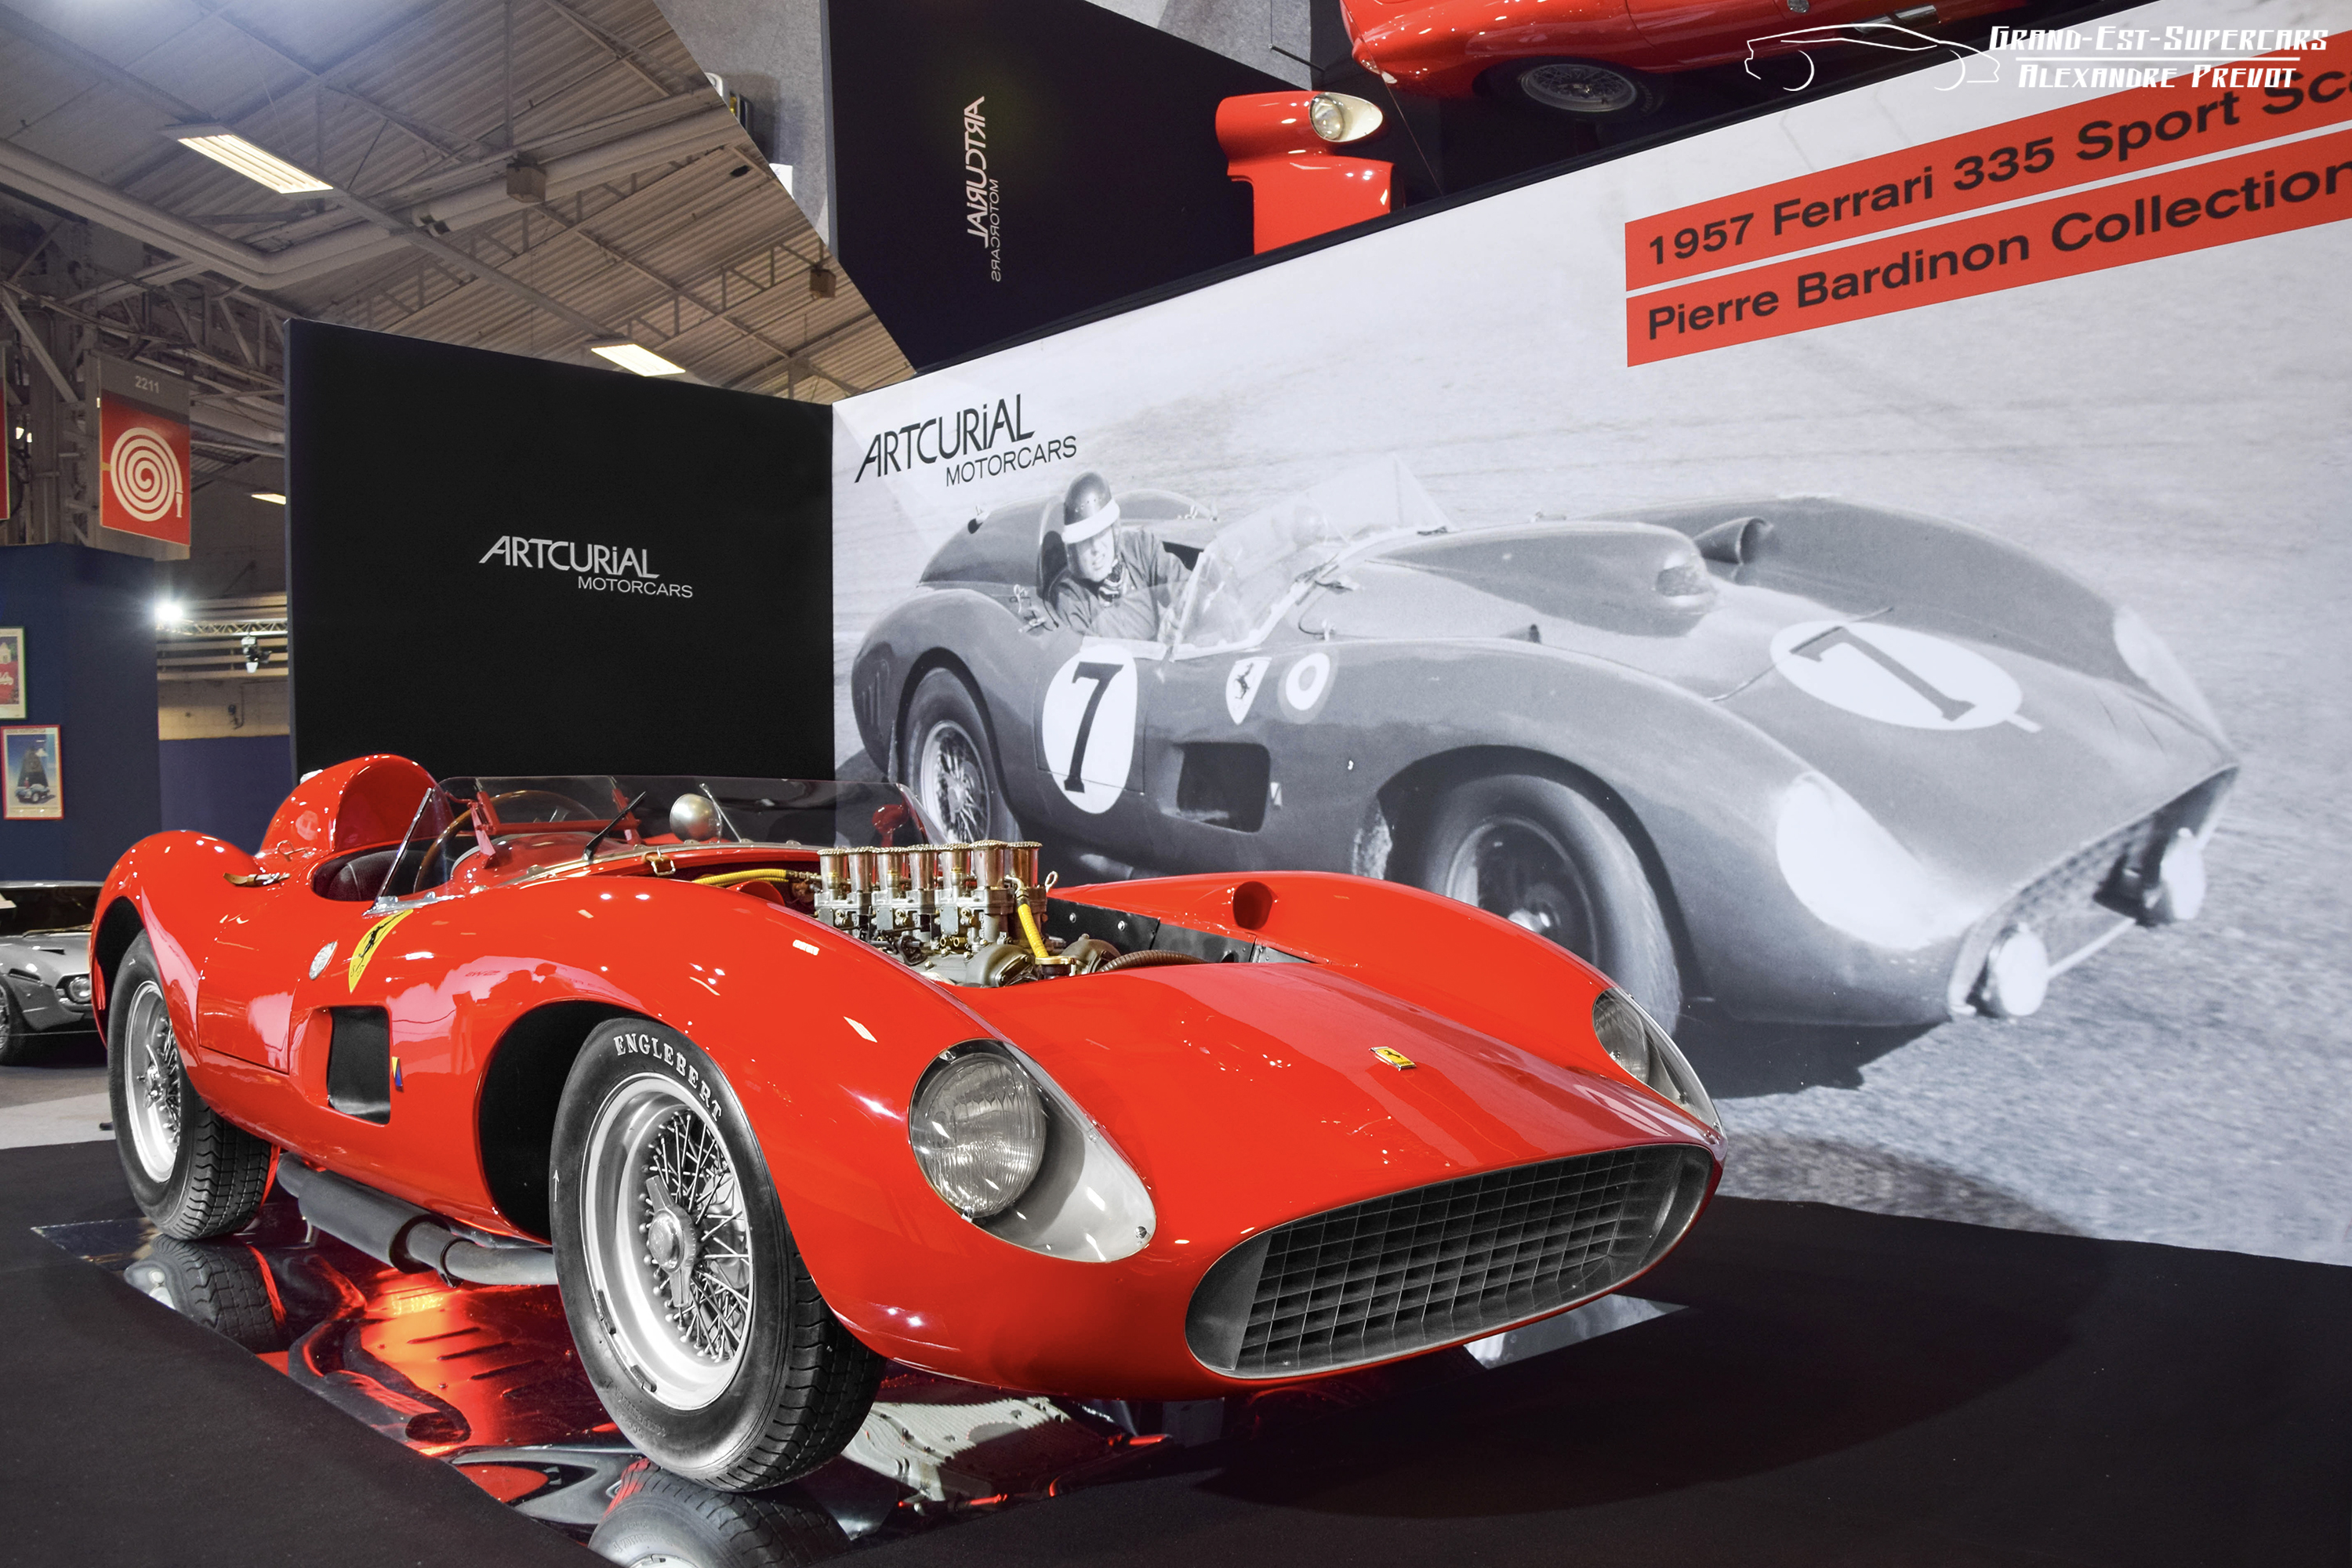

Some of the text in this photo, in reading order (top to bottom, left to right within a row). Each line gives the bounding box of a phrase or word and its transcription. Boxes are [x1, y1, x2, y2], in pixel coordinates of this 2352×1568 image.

[1649, 213, 1754, 265] 1957
[1773, 166, 1933, 235] Ferrari
[1953, 137, 2054, 191] 335
[2077, 92, 2240, 162] Sport
[1649, 290, 1779, 340] Pierre
[1798, 234, 2029, 308] Bardinon
[135, 376, 159, 394] 2211
[946, 435, 1077, 487] MOTORCARS
[578, 576, 693, 598] MOTORCARS
[1064, 662, 1124, 793] 7
[614, 1033, 722, 1121] ENGLEBERT
